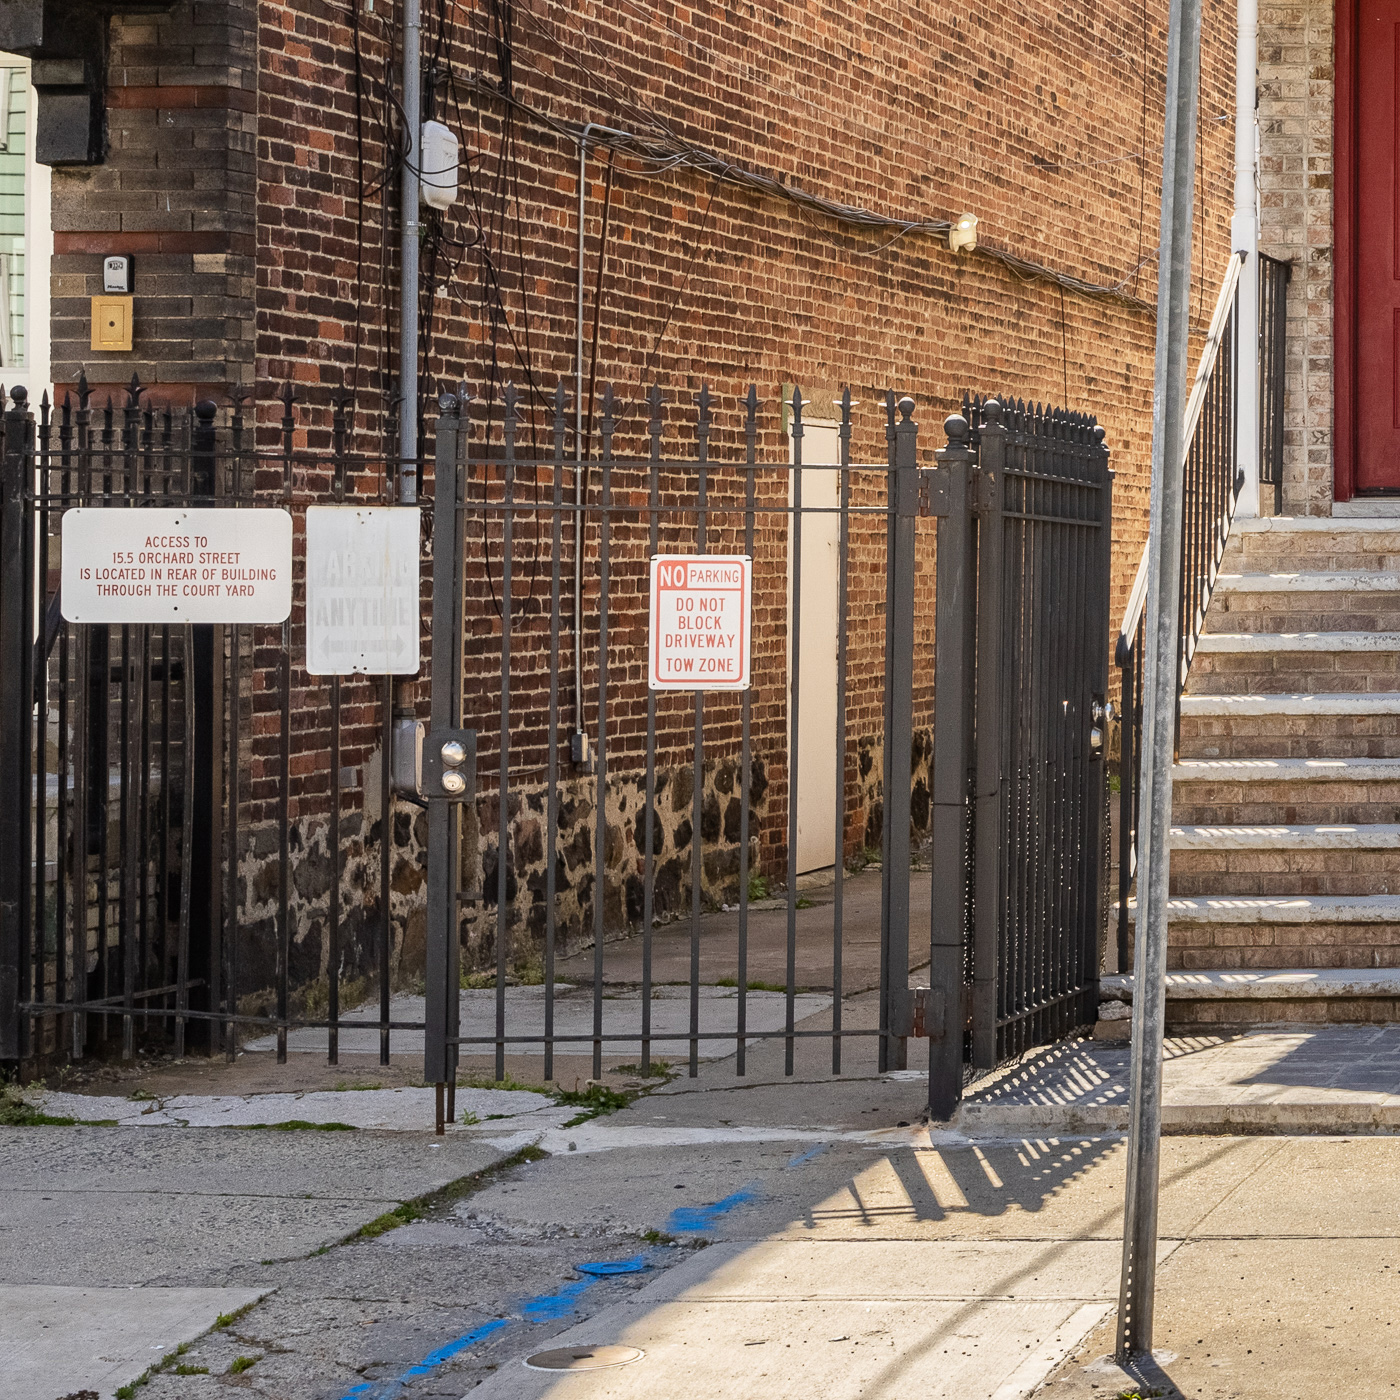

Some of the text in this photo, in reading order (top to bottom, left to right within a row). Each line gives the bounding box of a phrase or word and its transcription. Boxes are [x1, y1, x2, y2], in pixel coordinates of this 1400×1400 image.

[145, 536, 208, 548] ACCESS TO
[113, 552, 241, 564] 15.5 ORCHARD STREET
[80, 568, 277, 581] IS LOCATED IN REAR OF BUILDING
[660, 565, 739, 587] NO PARKING
[96, 584, 255, 597] THROUGH THE COURT YARD
[676, 597, 725, 612] DO NOT
[315, 597, 410, 627] ANYTIME
[678, 615, 722, 630] BLOCK
[665, 633, 735, 648] DRIVEWAY
[666, 658, 734, 672] TOW ZONE
